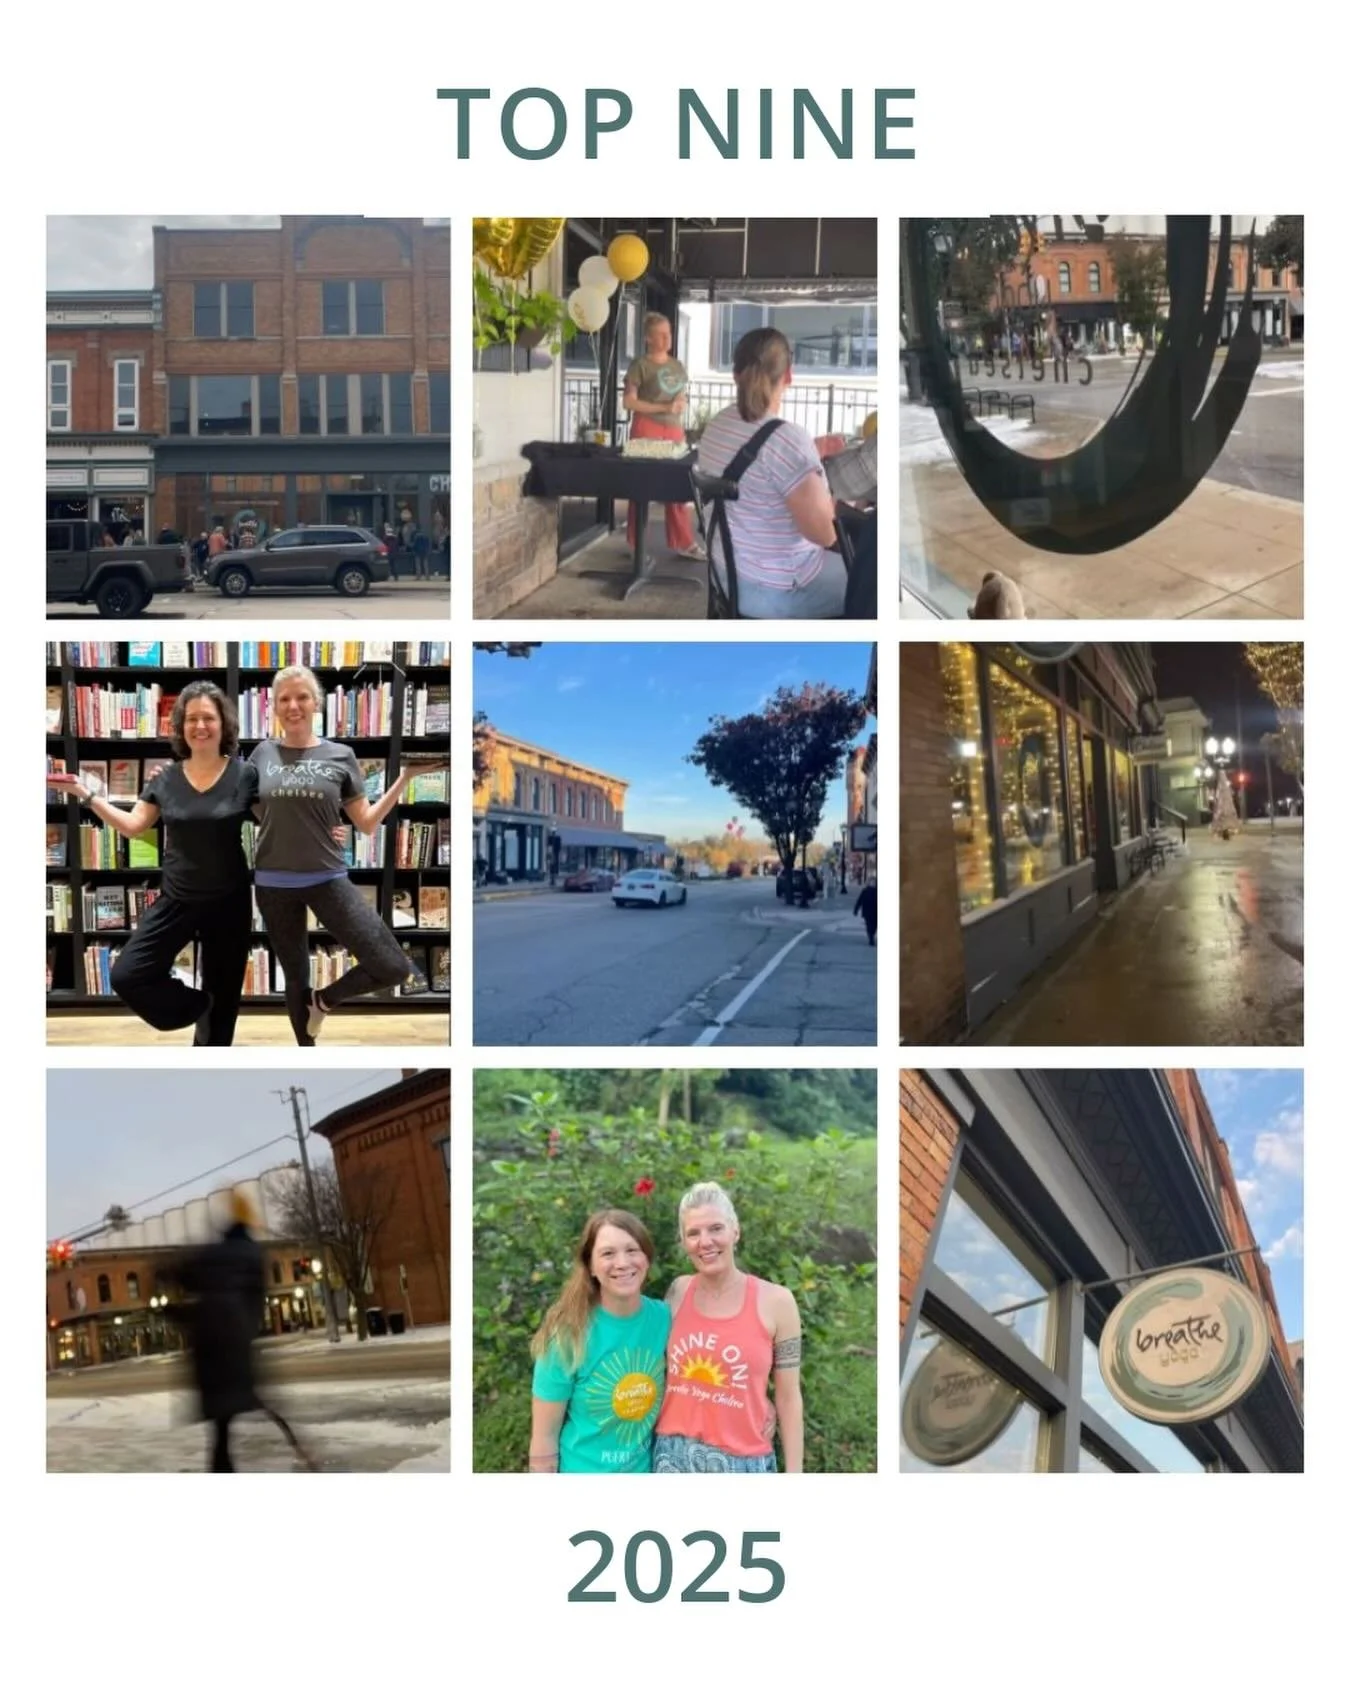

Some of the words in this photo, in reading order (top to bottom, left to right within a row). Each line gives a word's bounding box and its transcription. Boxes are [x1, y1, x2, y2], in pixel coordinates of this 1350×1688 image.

[266, 758, 333, 779] breathe
[271, 788, 324, 800] chelsea
[1135, 1315, 1224, 1352] breathe
[668, 1331, 719, 1376] SHINE
[721, 1344, 749, 1390] ON!
[1160, 1347, 1199, 1367] yoga
